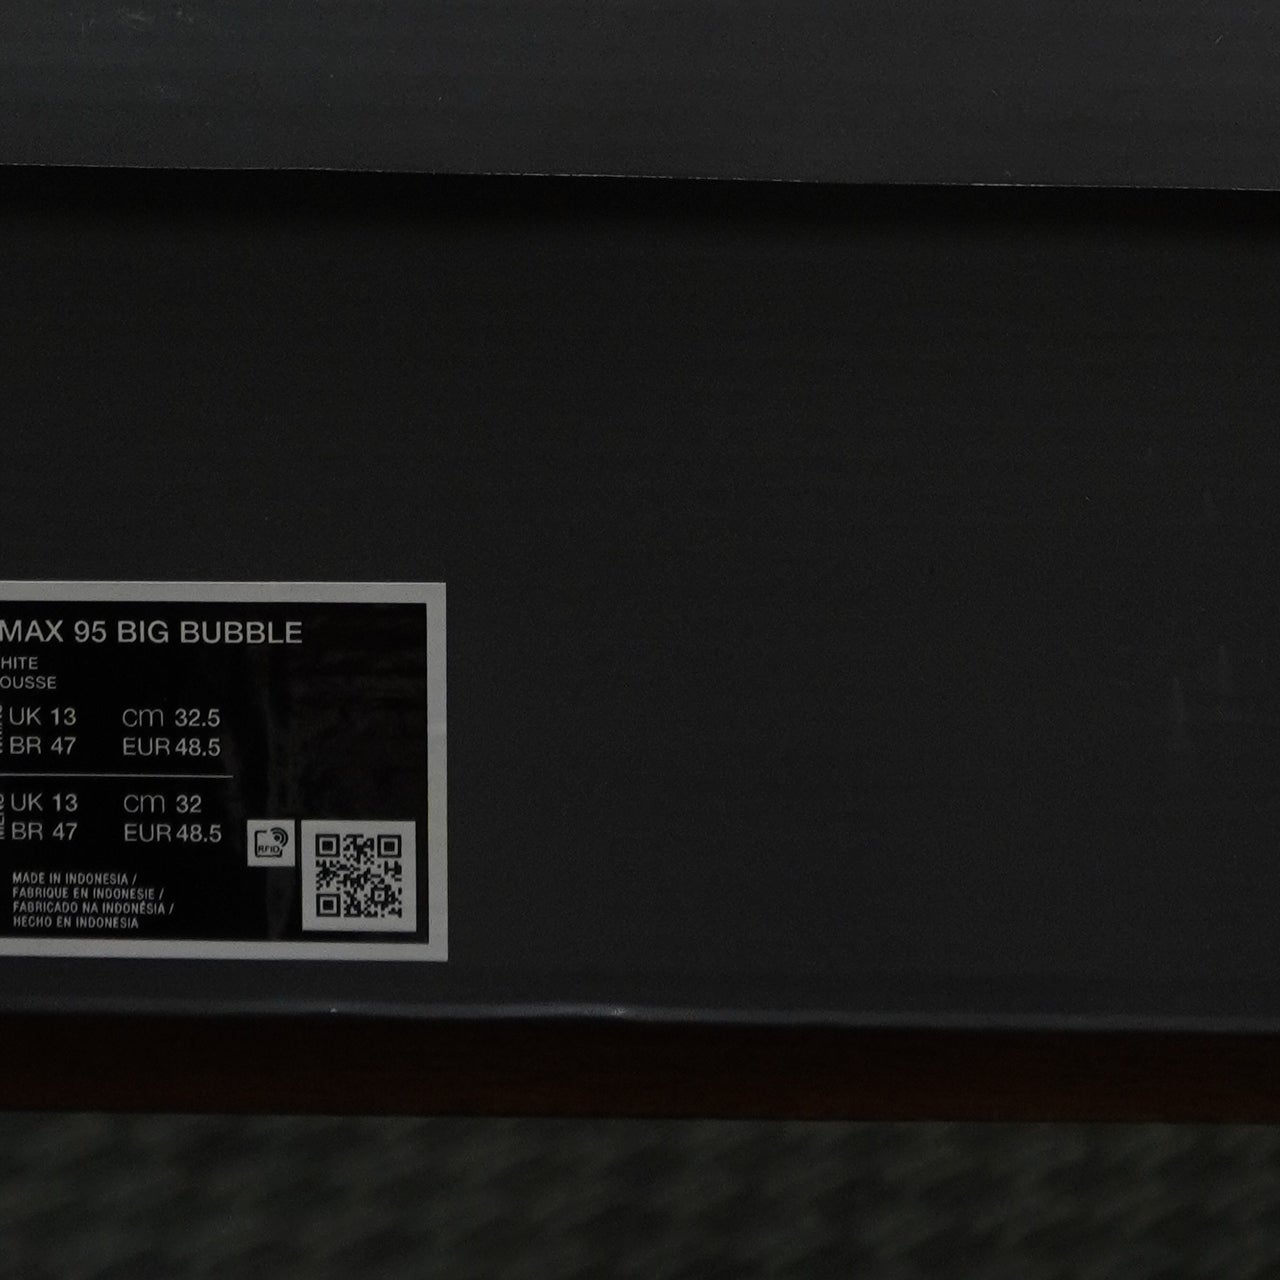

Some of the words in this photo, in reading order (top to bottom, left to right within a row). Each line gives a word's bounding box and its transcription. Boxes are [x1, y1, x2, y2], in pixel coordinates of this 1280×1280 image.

[74, 620, 107, 643] 95
[118, 620, 169, 643] BIG
[180, 621, 303, 644] BUBBLE
[9, 706, 42, 726] UK
[51, 707, 77, 726] 13
[174, 708, 220, 728] 32.5
[10, 736, 42, 755] BR
[51, 736, 77, 756] 47
[122, 737, 170, 756] EUR
[175, 737, 220, 757] 48.5
[11, 792, 43, 812] UK
[52, 793, 78, 812] 13
[176, 794, 202, 814] 32
[11, 822, 43, 841] BR
[52, 822, 78, 841] 47
[124, 823, 171, 842] EUR
[176, 823, 222, 843] 48.5
[12, 872, 45, 885] MADE
[49, 872, 61, 885] IN
[66, 872, 128, 885] INDONESIA
[12, 886, 69, 899] FABRIQUE
[73, 887, 89, 899] EN
[13, 901, 78, 914] FABRICADO
[82, 901, 99, 914] NA
[102, 900, 165, 915] INDONÉSIA
[13, 916, 52, 928] HECHO
[56, 916, 71, 928] EN
[76, 916, 139, 929] INDONESIA
